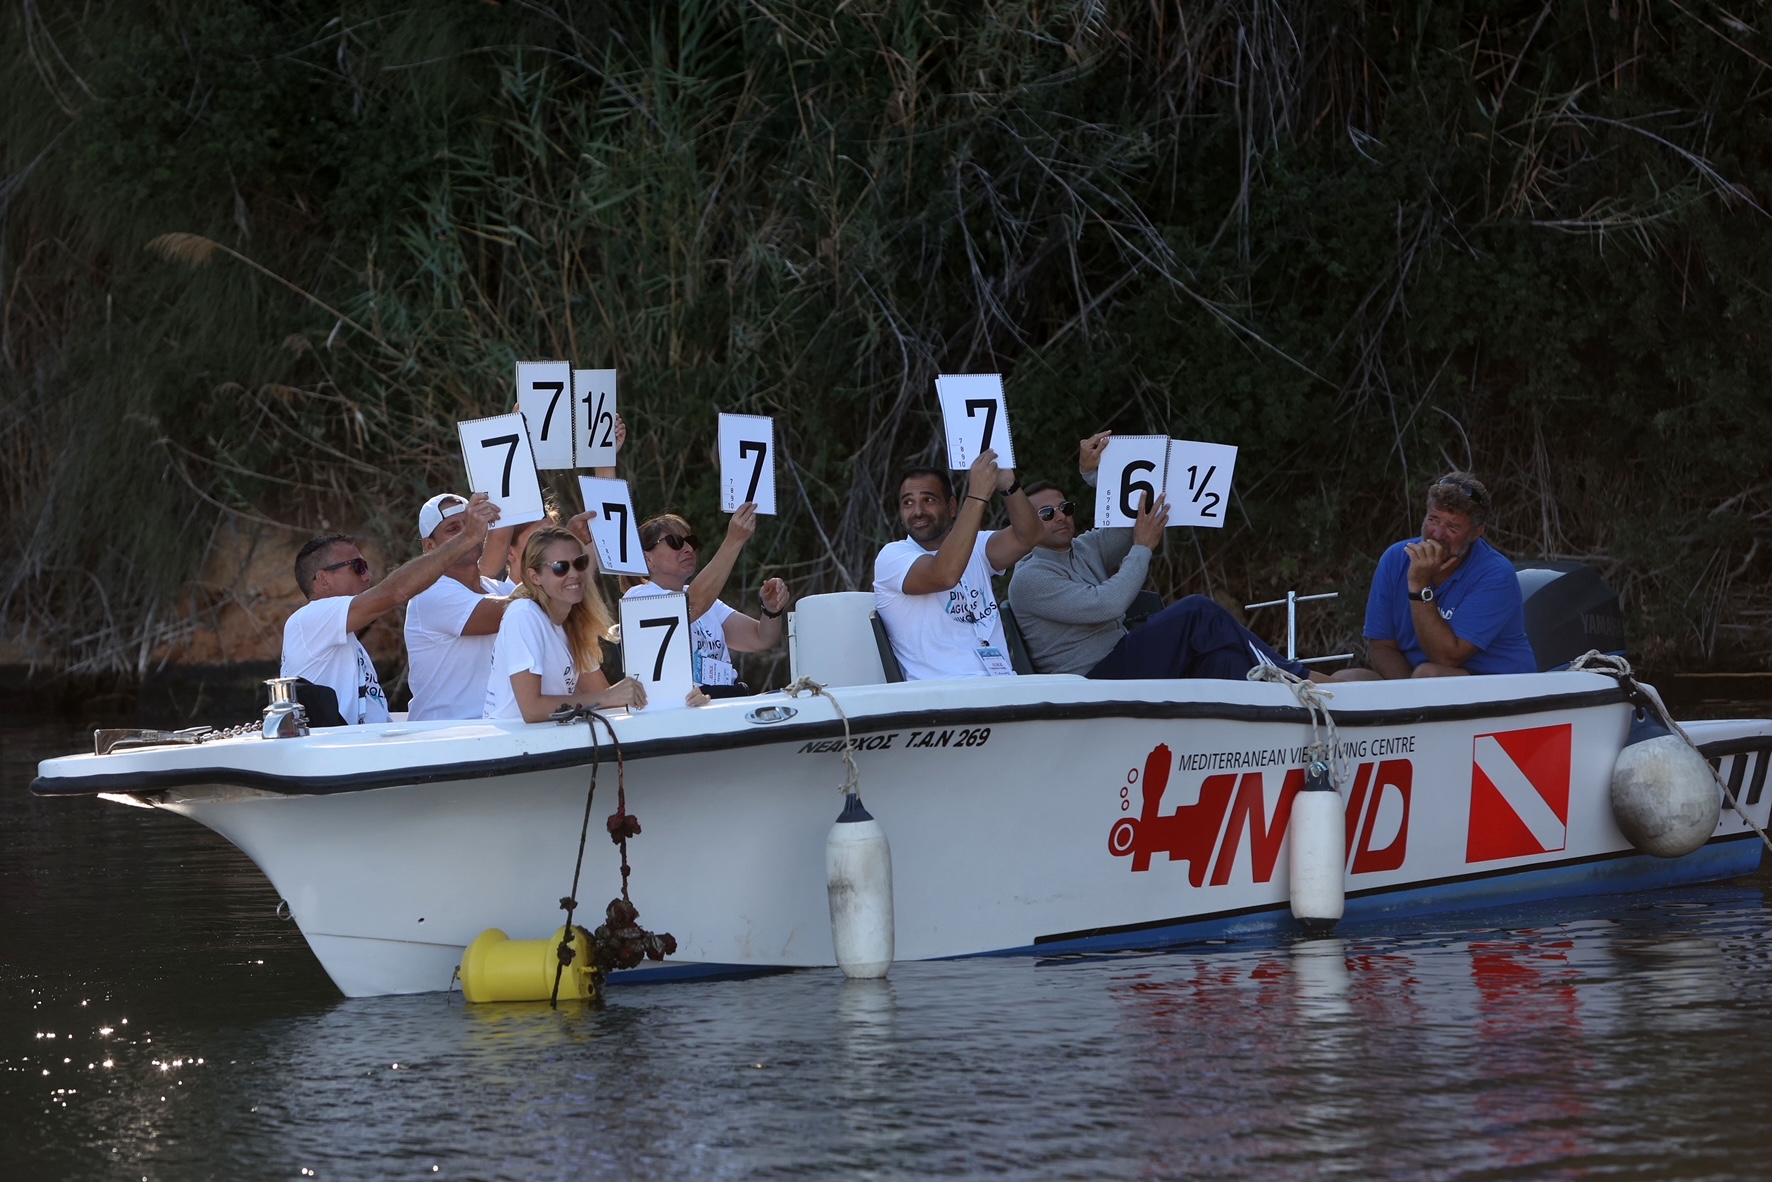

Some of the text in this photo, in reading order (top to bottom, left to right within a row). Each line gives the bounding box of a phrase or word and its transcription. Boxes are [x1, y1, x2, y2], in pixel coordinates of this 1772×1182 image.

[532, 381, 564, 441] 7
[965, 399, 998, 454] 7
[481, 433, 520, 498] 7
[739, 440, 767, 502] 7
[1119, 459, 1156, 519] 6
[602, 502, 628, 563] 7
[633, 673, 640, 681] 7
[639, 616, 680, 682] 7
[953, 727, 991, 747] 269
[1178, 747, 1287, 772] MEDITERRANEAN
[1290, 746, 1317, 764] VIE
[1371, 735, 1416, 756] CENTRE
